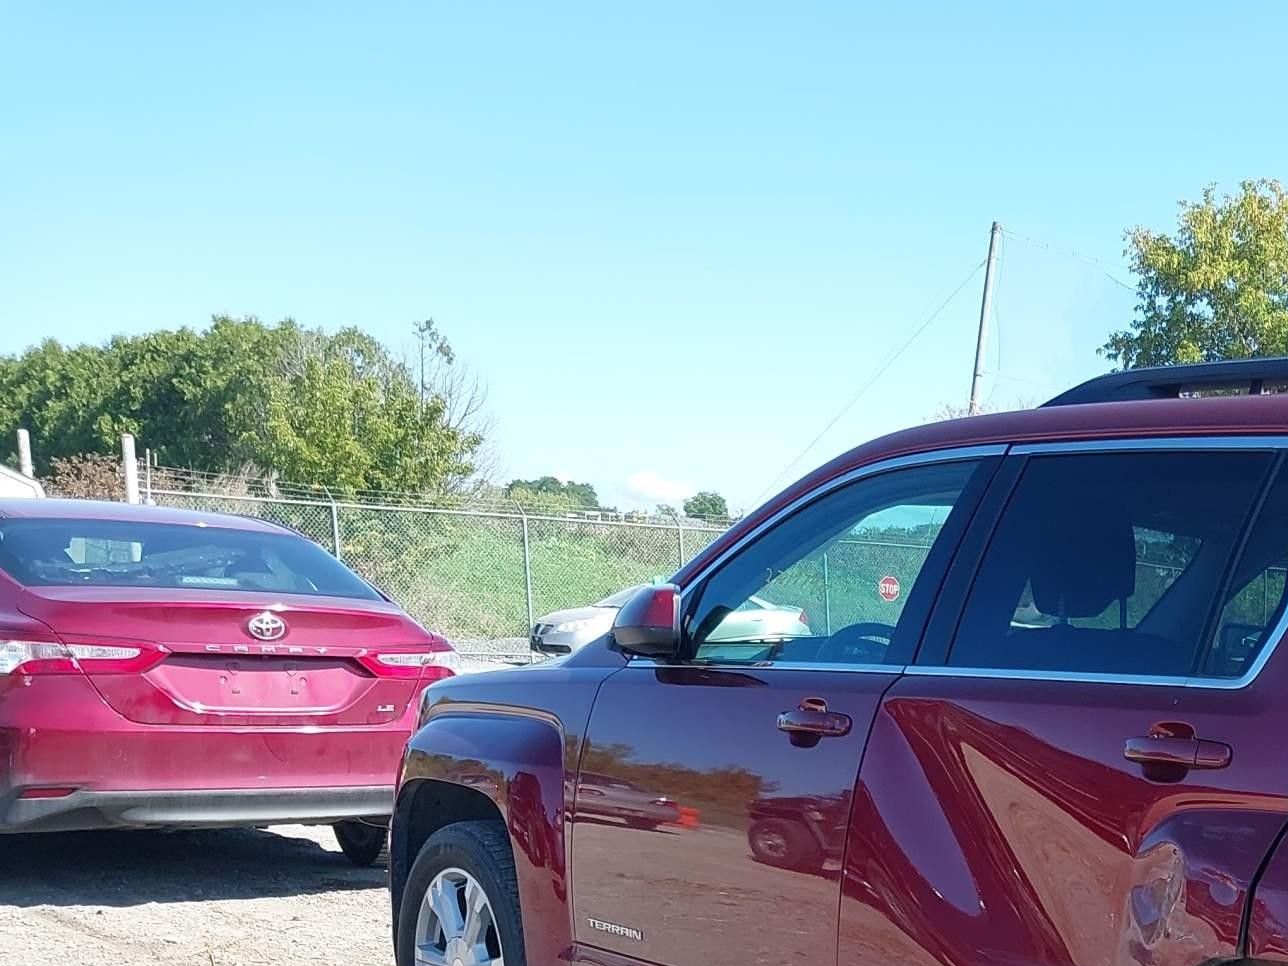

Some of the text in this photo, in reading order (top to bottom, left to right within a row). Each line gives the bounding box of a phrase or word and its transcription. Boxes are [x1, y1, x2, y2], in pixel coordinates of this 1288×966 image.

[880, 583, 899, 595] STOP
[205, 643, 329, 655] CAMRY
[376, 704, 395, 712] LE
[586, 917, 643, 941] TERRAIN
